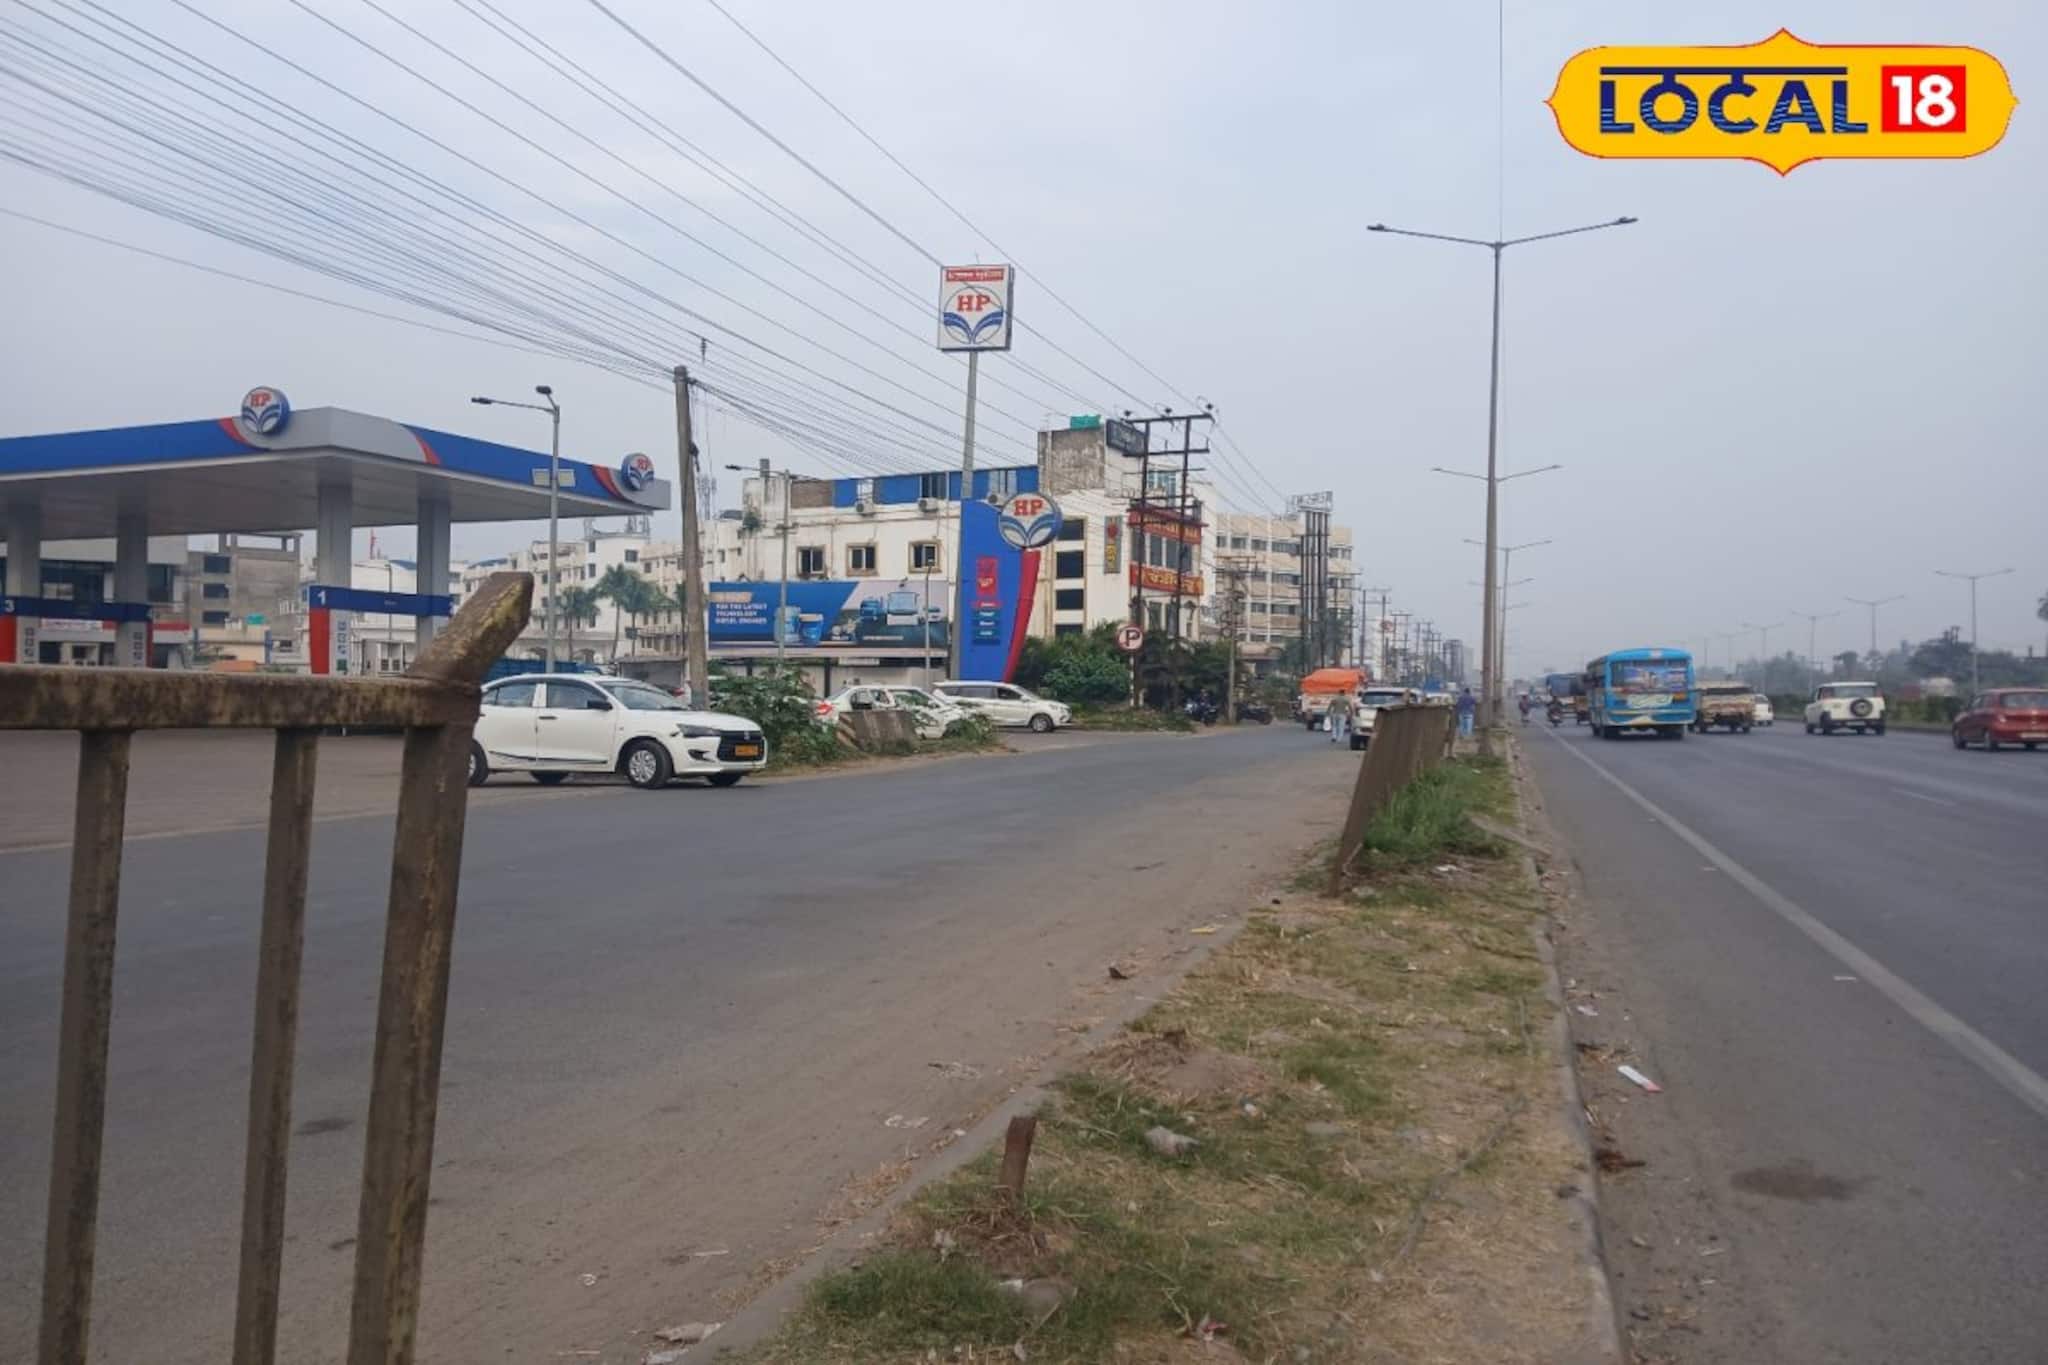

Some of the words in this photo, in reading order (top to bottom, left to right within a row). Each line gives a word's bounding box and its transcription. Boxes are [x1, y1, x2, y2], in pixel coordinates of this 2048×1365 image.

[957, 294, 990, 312] HP
[249, 392, 272, 407] HP
[1014, 499, 1043, 516] HP
[318, 590, 326, 605] 1
[5, 600, 15, 612] 3
[1125, 629, 1140, 647] P
